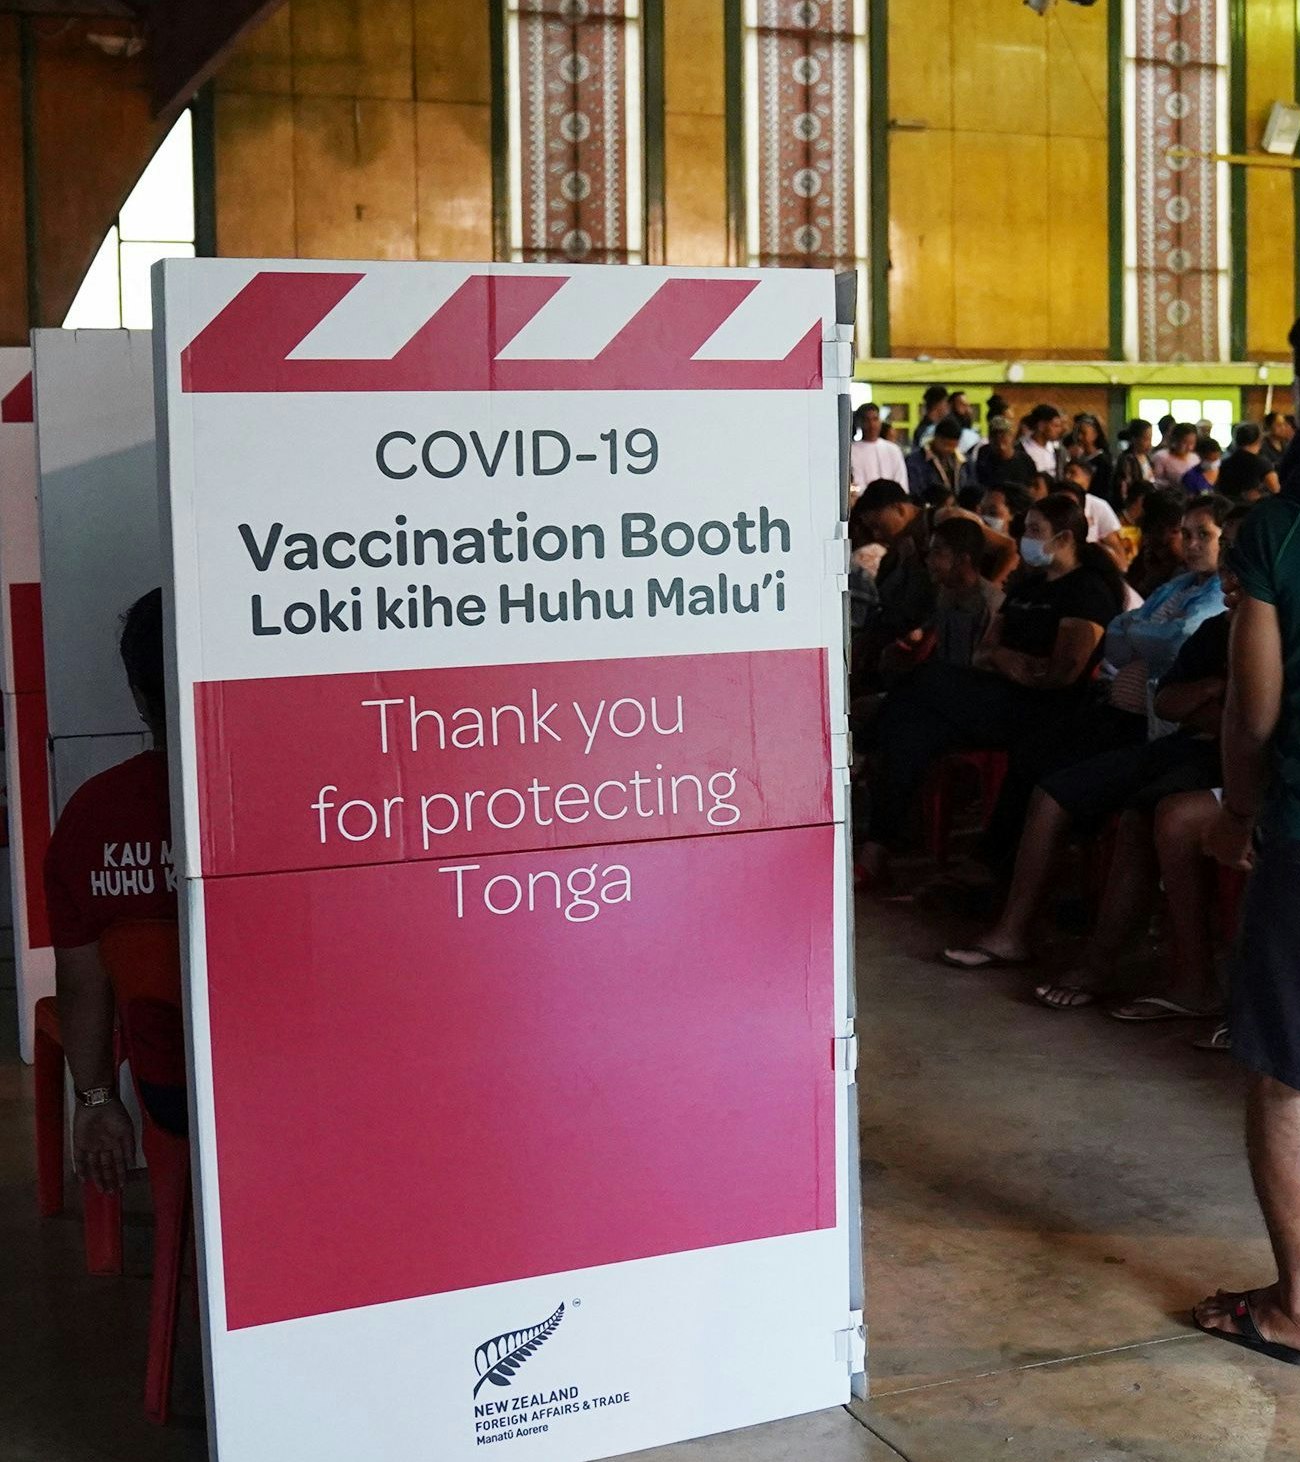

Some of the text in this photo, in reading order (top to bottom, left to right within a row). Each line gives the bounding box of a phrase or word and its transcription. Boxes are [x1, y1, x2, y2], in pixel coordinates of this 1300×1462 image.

[375, 427, 659, 480] COVID-19
[237, 505, 791, 572] Vaccination Booth
[251, 569, 786, 637] Loki kihe Huhu Malu'i
[361, 688, 684, 755] Thank you
[310, 763, 742, 850] for protecting
[103, 841, 151, 868] KAU
[90, 868, 155, 896] HUHU
[438, 862, 632, 923] Tonga
[474, 1386, 579, 1418] NEW ZEALAND
[475, 1391, 631, 1433] FOREIGN AFFAIRS & TRADE
[516, 1424, 549, 1438] Aorere
